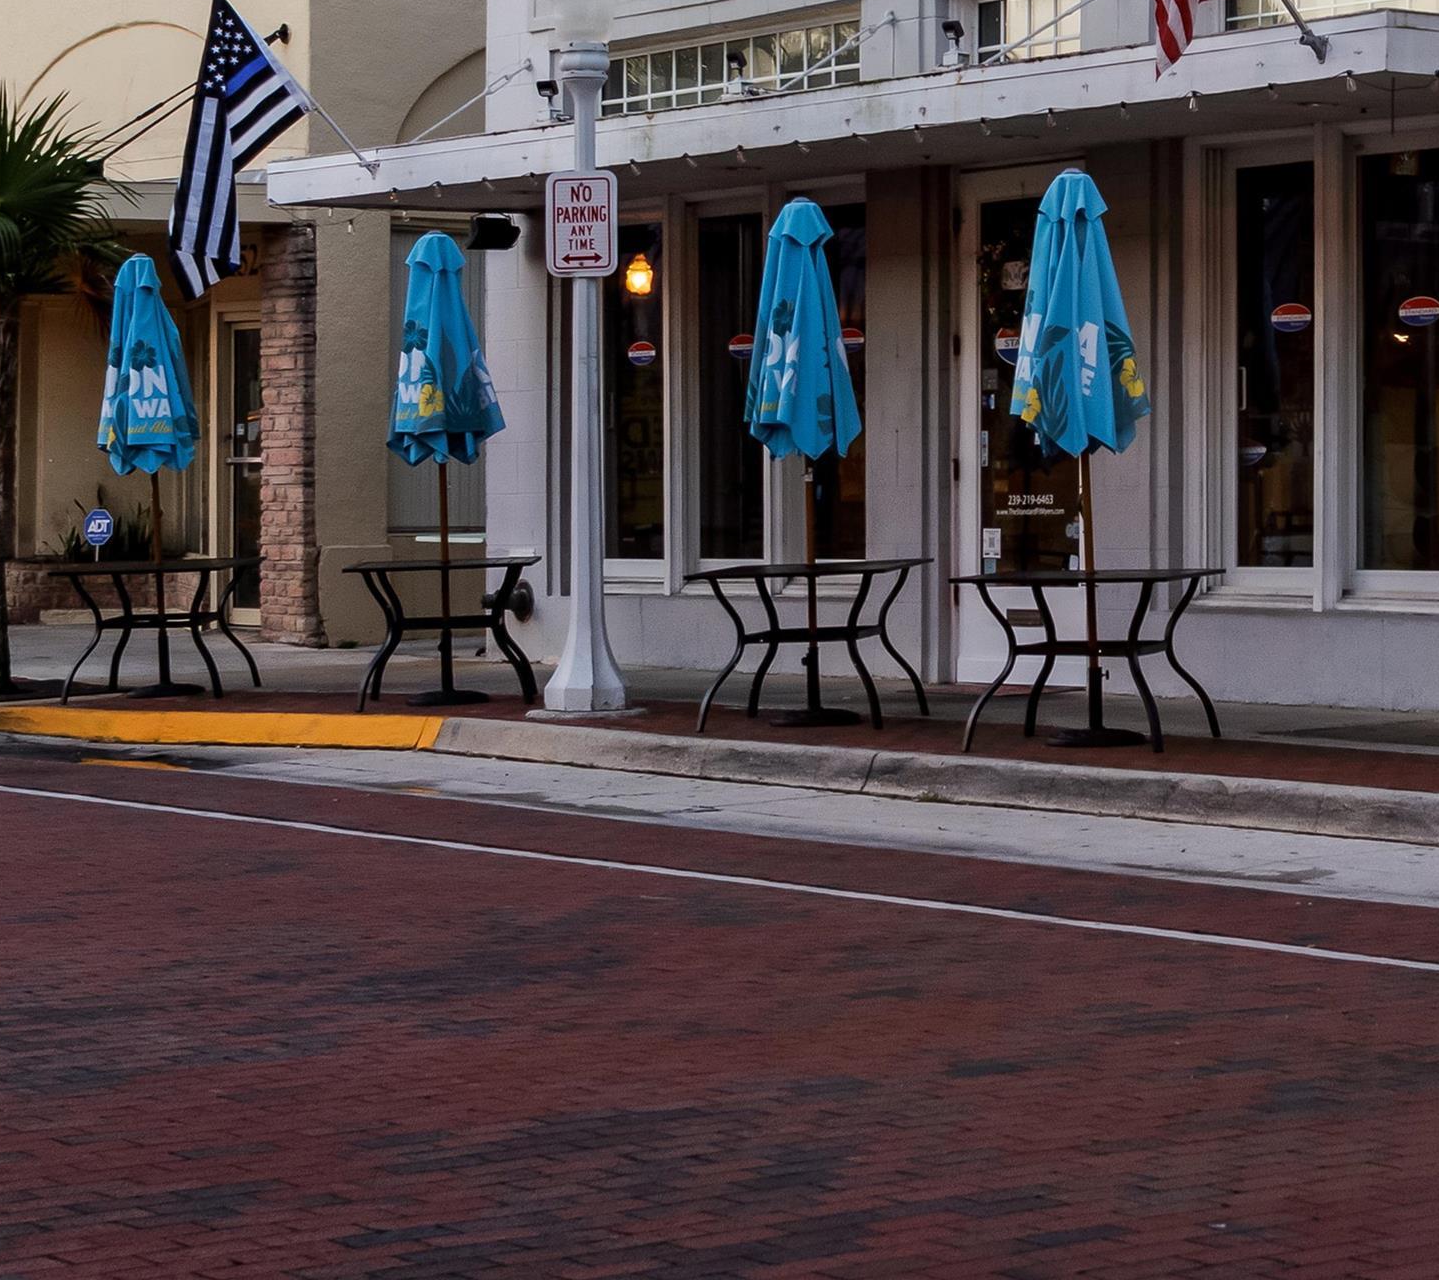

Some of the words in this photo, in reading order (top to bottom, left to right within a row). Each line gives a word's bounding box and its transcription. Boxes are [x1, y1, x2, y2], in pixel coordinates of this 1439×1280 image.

[570, 185, 592, 203] NO
[556, 205, 607, 223] PARKING
[570, 225, 593, 236] ANY
[568, 238, 596, 250] TIME
[87, 519, 111, 534] ADT
